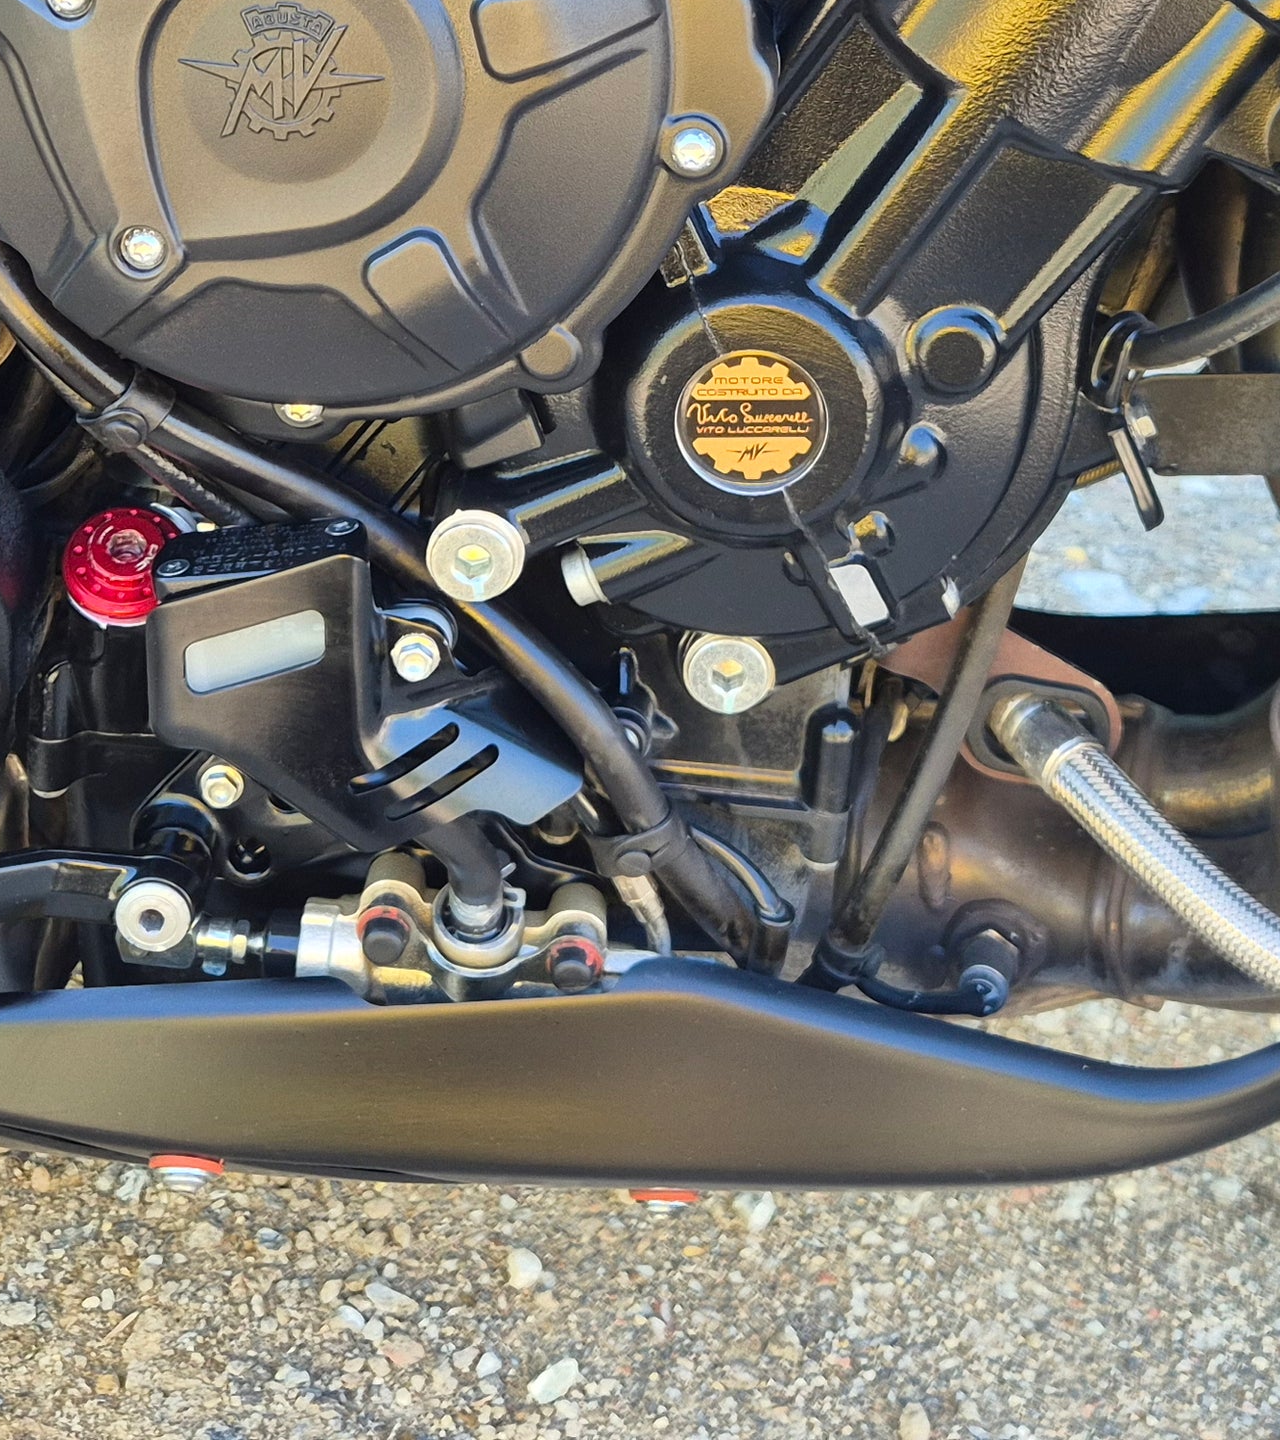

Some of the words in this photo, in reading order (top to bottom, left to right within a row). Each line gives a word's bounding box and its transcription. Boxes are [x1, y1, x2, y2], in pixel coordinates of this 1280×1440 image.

[250, 10, 326, 36] AGUSTA
[221, 24, 348, 138] MV
[714, 376, 784, 385] MOTORE
[696, 388, 778, 397] COSTRUITO
[782, 387, 803, 396] DA
[696, 426, 725, 434] VITO
[727, 426, 809, 434] LUCCARELLI
[737, 442, 768, 463] MV
